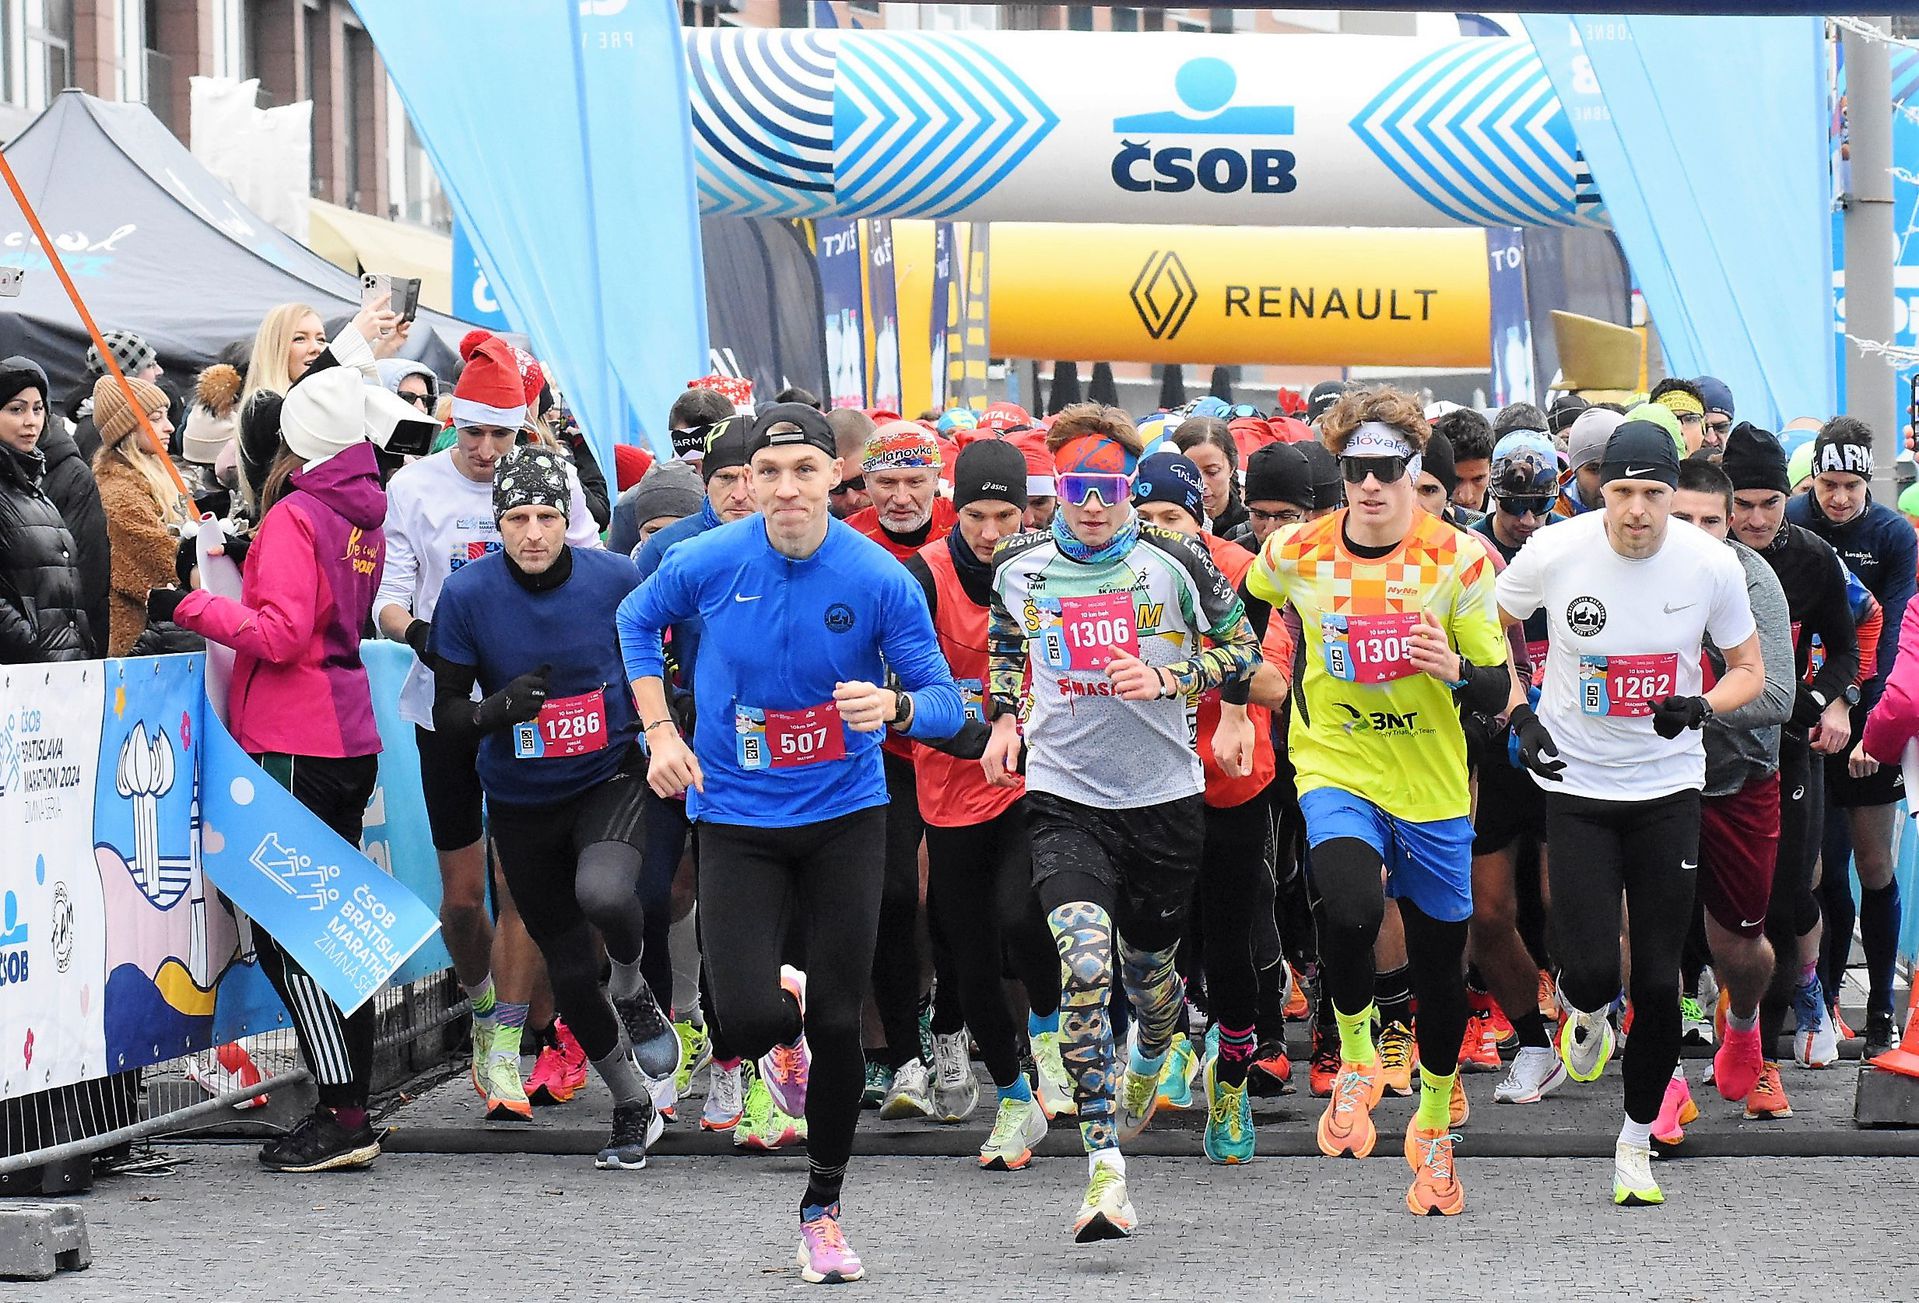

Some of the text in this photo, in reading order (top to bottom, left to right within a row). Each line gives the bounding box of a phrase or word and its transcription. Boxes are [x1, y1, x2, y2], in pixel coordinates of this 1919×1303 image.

[1111, 138, 1297, 193] ČSOB
[1225, 284, 1438, 321] RENAULT
[1346, 434, 1410, 458] slovakia
[1183, 537, 1216, 578] LEVICE
[1070, 617, 1129, 647] 1306
[1356, 637, 1412, 663] 1305
[1614, 673, 1670, 699] 1262
[546, 711, 600, 740] 1286
[1369, 711, 1418, 731] 3NT
[21, 737, 64, 764] BRATISLAVA
[780, 726, 828, 755] 507
[24, 765, 81, 794] MARATHON 2024
[353, 883, 397, 930] ČSOB
[340, 900, 401, 967] BRATISLA
[314, 931, 358, 981] ZIMNÁ
[327, 915, 390, 984] MARATHO
